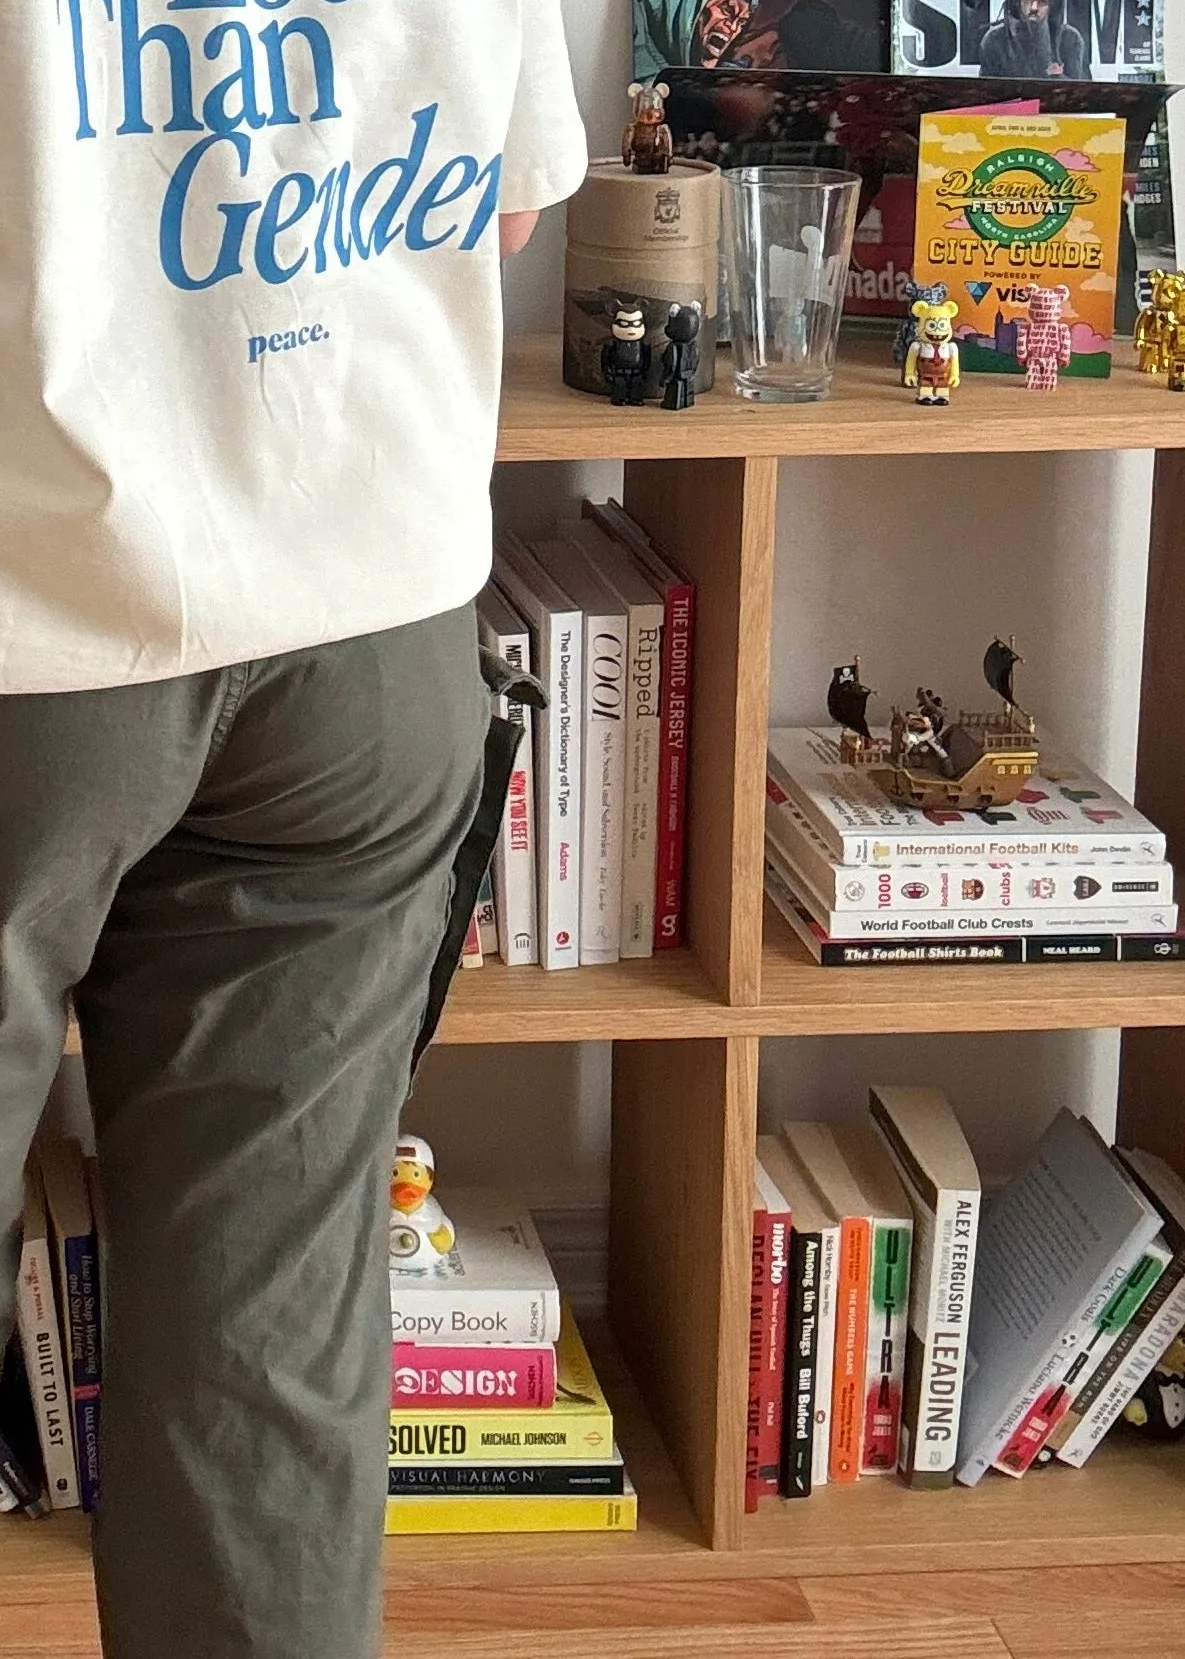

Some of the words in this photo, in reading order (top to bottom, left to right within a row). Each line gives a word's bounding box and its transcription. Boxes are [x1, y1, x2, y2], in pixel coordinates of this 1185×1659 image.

[985, 153, 1056, 174] RALEIGH
[159, 102, 504, 291] Gender
[936, 167, 1099, 204] Dreamville
[969, 200, 1068, 215] FESTIVAL
[928, 238, 1000, 265] CITY
[1008, 241, 1102, 269] GUIDE
[848, 261, 913, 302] nada
[996, 283, 1031, 303] vis
[247, 321, 331, 363] peace.
[672, 597, 689, 629] THE
[559, 630, 571, 653] The
[669, 631, 688, 689] ICONIC
[559, 654, 571, 715] Designer's
[634, 627, 658, 720] Ripped
[667, 690, 686, 748] JERSEY
[559, 716, 571, 774] Dictionary
[558, 789, 570, 817] Type
[560, 842, 569, 882] Adams
[896, 842, 985, 855] International
[989, 842, 1047, 855] Football
[1051, 842, 1080, 854] Kits
[878, 873, 892, 910] 1000
[1000, 872, 1011, 906] clubs
[861, 919, 899, 931] World
[902, 919, 955, 932] Football
[958, 918, 987, 930] Club
[991, 917, 1034, 930] Crests
[844, 948, 869, 961] The
[871, 947, 926, 960] Football
[928, 947, 966, 959] Shirts
[969, 946, 1004, 959] Book
[954, 1198, 973, 1239] ALEX
[770, 1222, 788, 1285] morbo
[801, 1240, 819, 1289] Among
[803, 1290, 815, 1312] the
[947, 1243, 968, 1324] FERGUSON
[390, 1310, 444, 1335] Copy
[452, 1310, 508, 1332] Book
[798, 1316, 814, 1357] Thugs
[35, 1332, 55, 1377] BUILT
[43, 1380, 57, 1402] TO
[395, 1368, 518, 1397] DESIGN
[798, 1368, 811, 1390] Bill
[925, 1330, 961, 1443] LEADING
[45, 1409, 65, 1447] LAST
[795, 1393, 809, 1439] Buford
[481, 1432, 521, 1446] MICHAEL
[523, 1431, 567, 1445] JOHNSON
[391, 1468, 448, 1484] VISUAL
[456, 1469, 547, 1484] HARMONY
